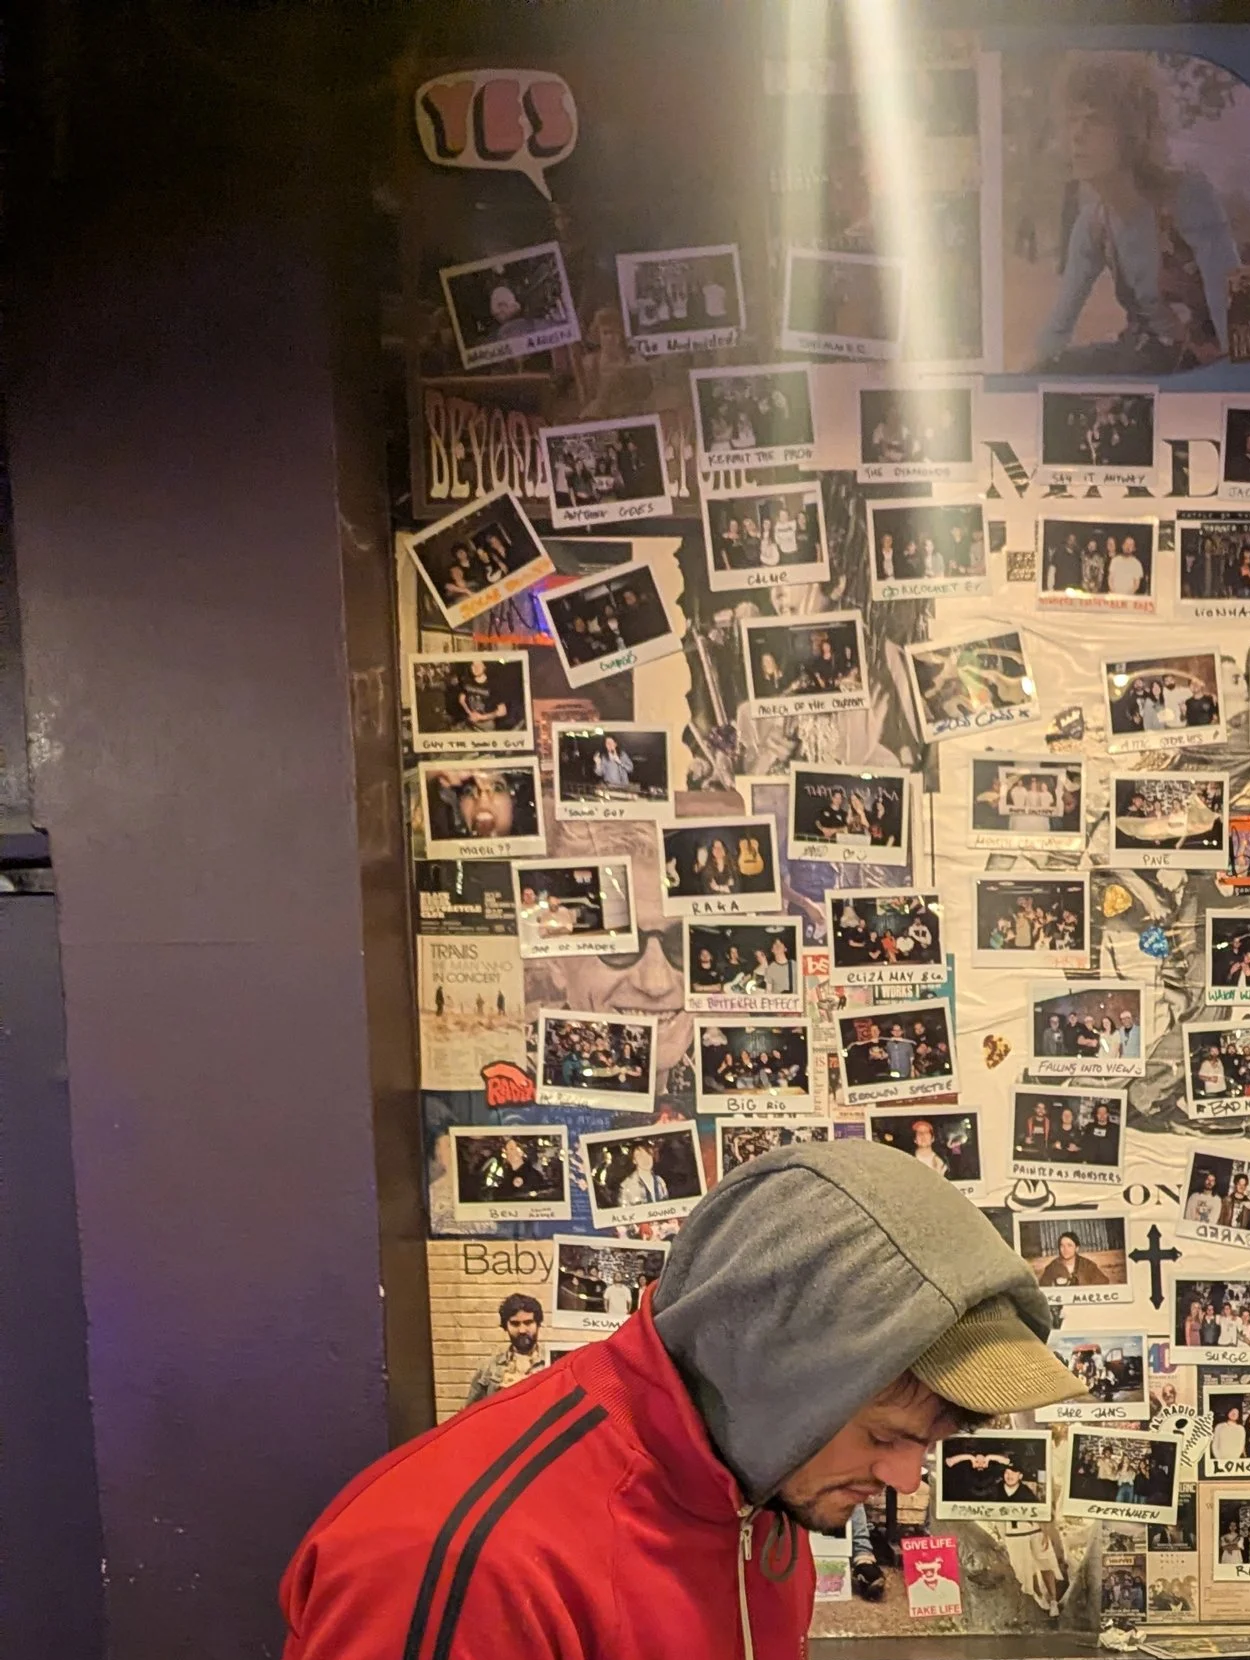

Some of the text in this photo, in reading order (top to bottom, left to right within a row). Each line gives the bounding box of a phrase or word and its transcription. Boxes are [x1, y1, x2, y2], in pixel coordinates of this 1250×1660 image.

[423, 739, 442, 749] GUY
[504, 739, 526, 748] GUY
[603, 809, 625, 818] GUY
[692, 901, 740, 915] RAGA
[431, 944, 478, 960] TRAVIS
[890, 972, 913, 981] MAY
[1039, 1060, 1078, 1074] FALLING
[1080, 1062, 1104, 1073] INTO
[1209, 1099, 1243, 1116] BAD
[463, 1244, 554, 1281] Baby
[1088, 1505, 1161, 1519] EVERYWHEN
[902, 1541, 929, 1550] GIVE
[911, 1604, 961, 1615] TAKE LIFE
